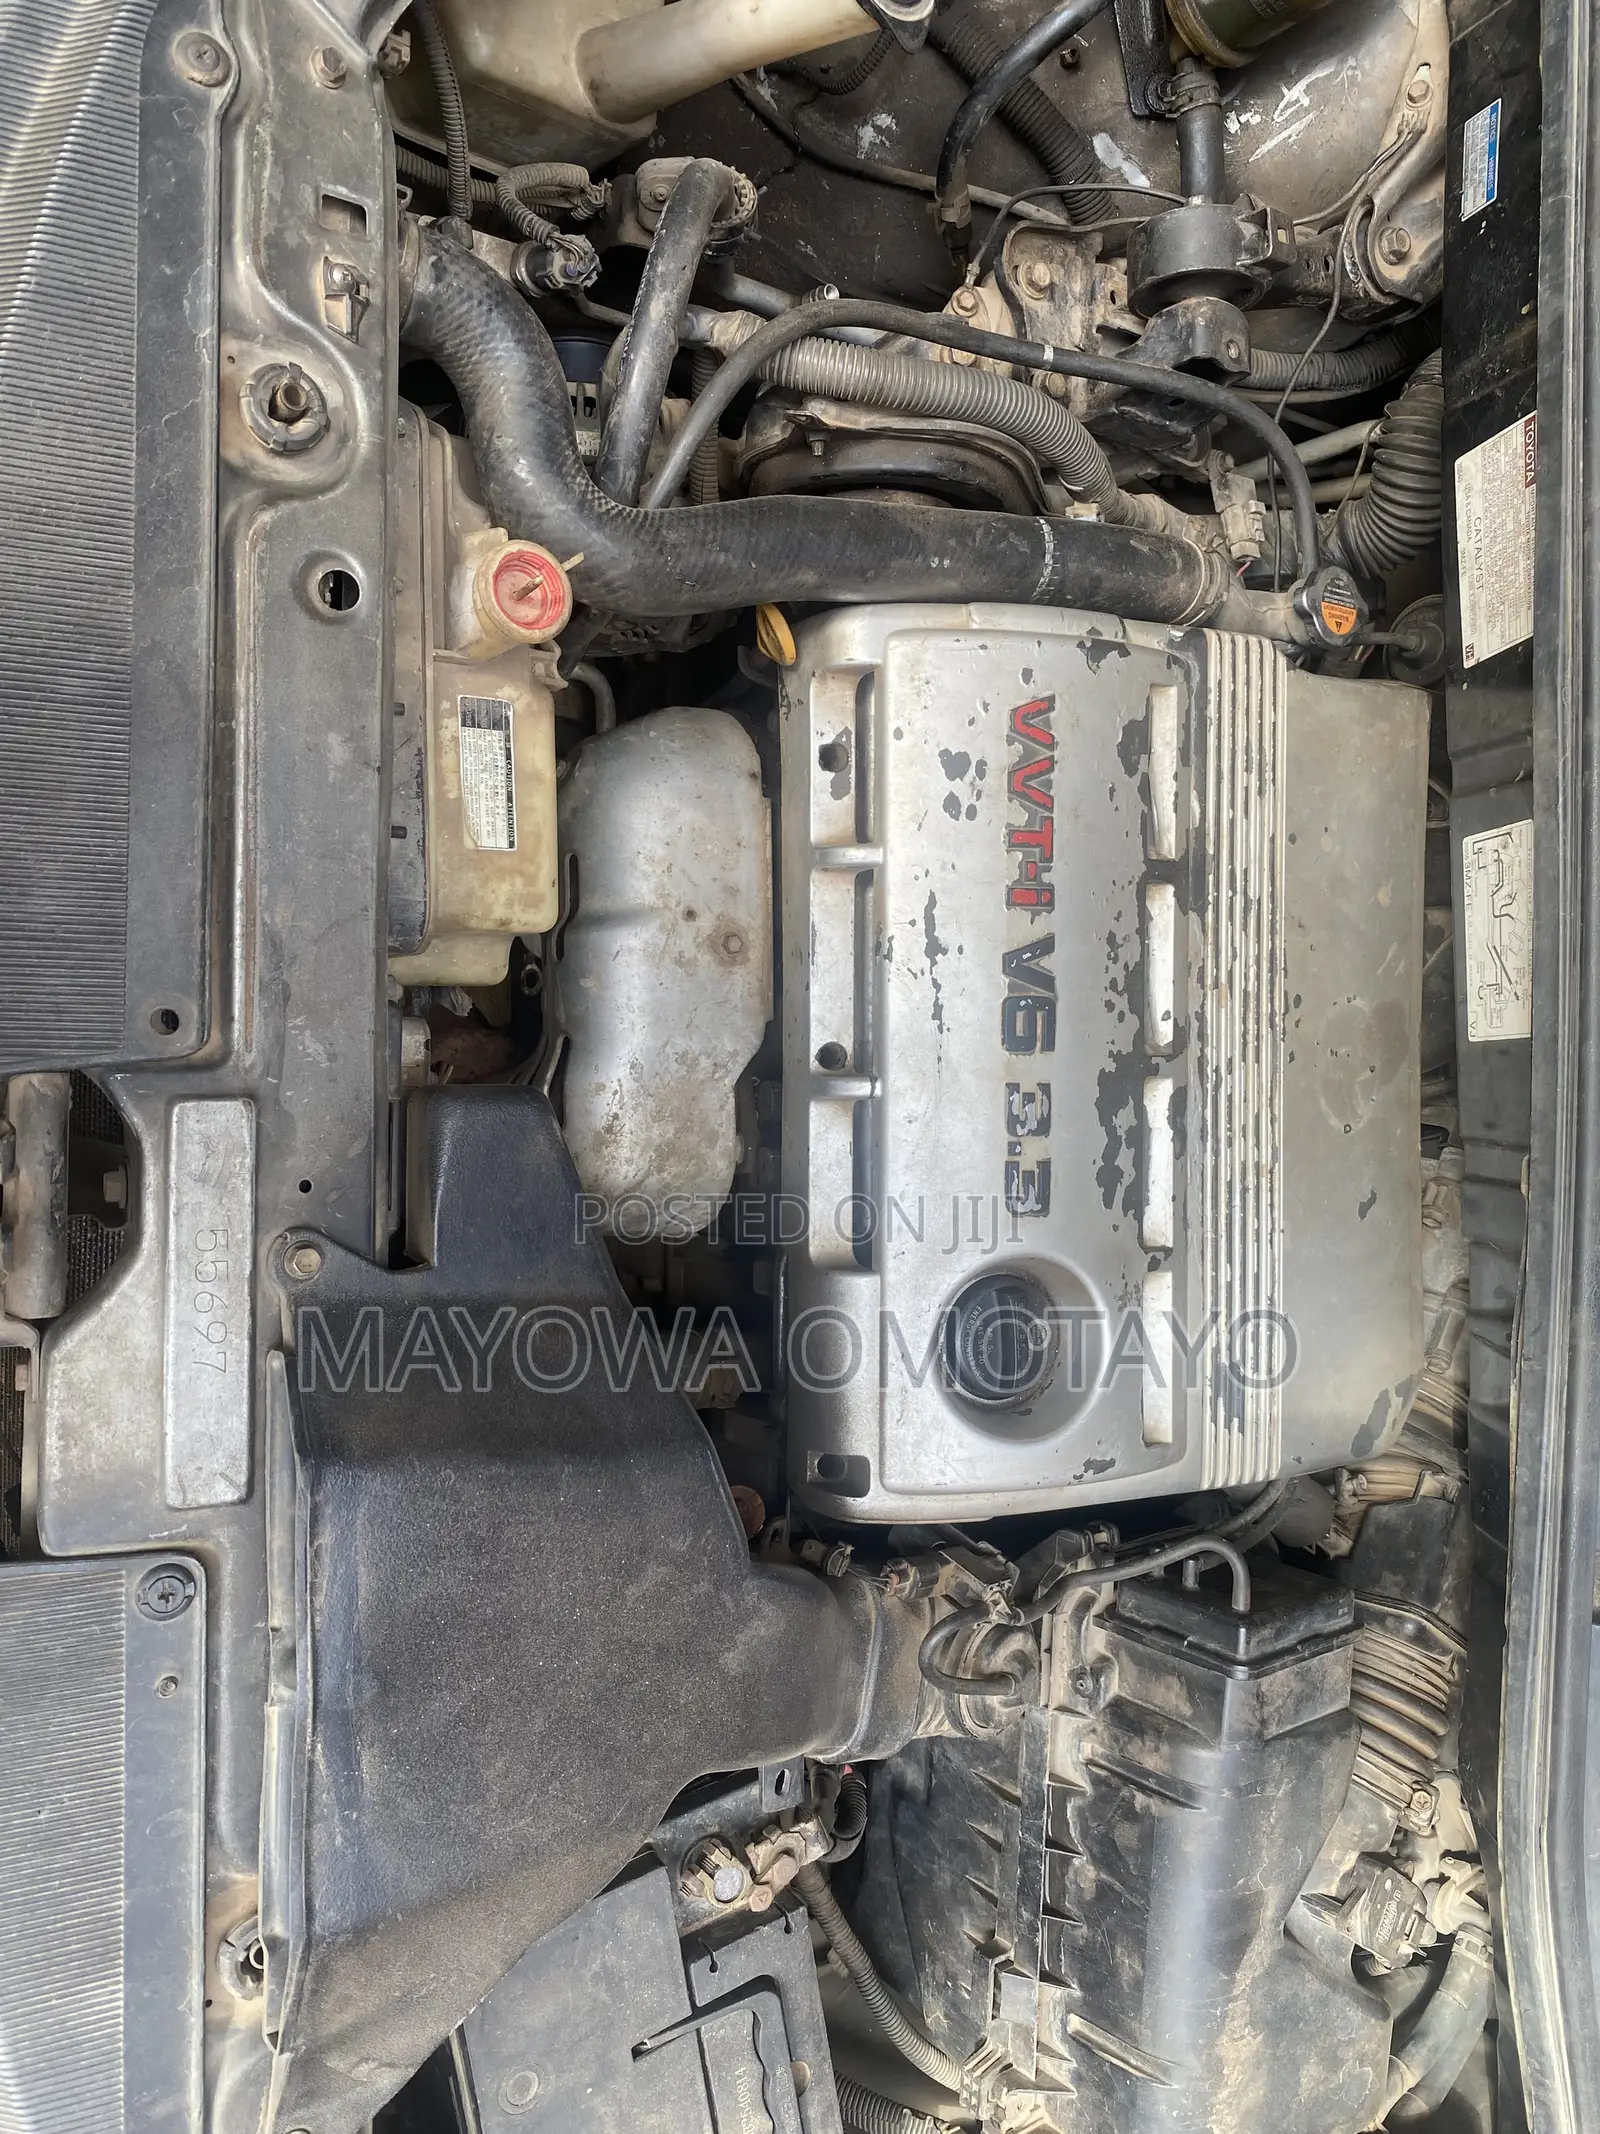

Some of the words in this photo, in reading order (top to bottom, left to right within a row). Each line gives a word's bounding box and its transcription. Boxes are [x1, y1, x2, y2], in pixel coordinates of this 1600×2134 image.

[1490, 112, 1498, 143] NOTICE
[1525, 421, 1535, 483] TOYOTA
[1474, 516, 1484, 591] CATALYST
[1465, 644, 1474, 661] VH
[505, 759, 513, 791] CAUTION
[507, 802, 515, 841] ATTENTION
[1006, 694, 1056, 914] VVT-i
[1464, 862, 1472, 911] 3MZ-FE
[1002, 933, 1057, 1057] V6
[1469, 1021, 1476, 1038] VJ
[1005, 1083, 1052, 1218] 3.3
[193, 1229, 229, 1373] 55697
[966, 1306, 982, 1332] ENERGY
